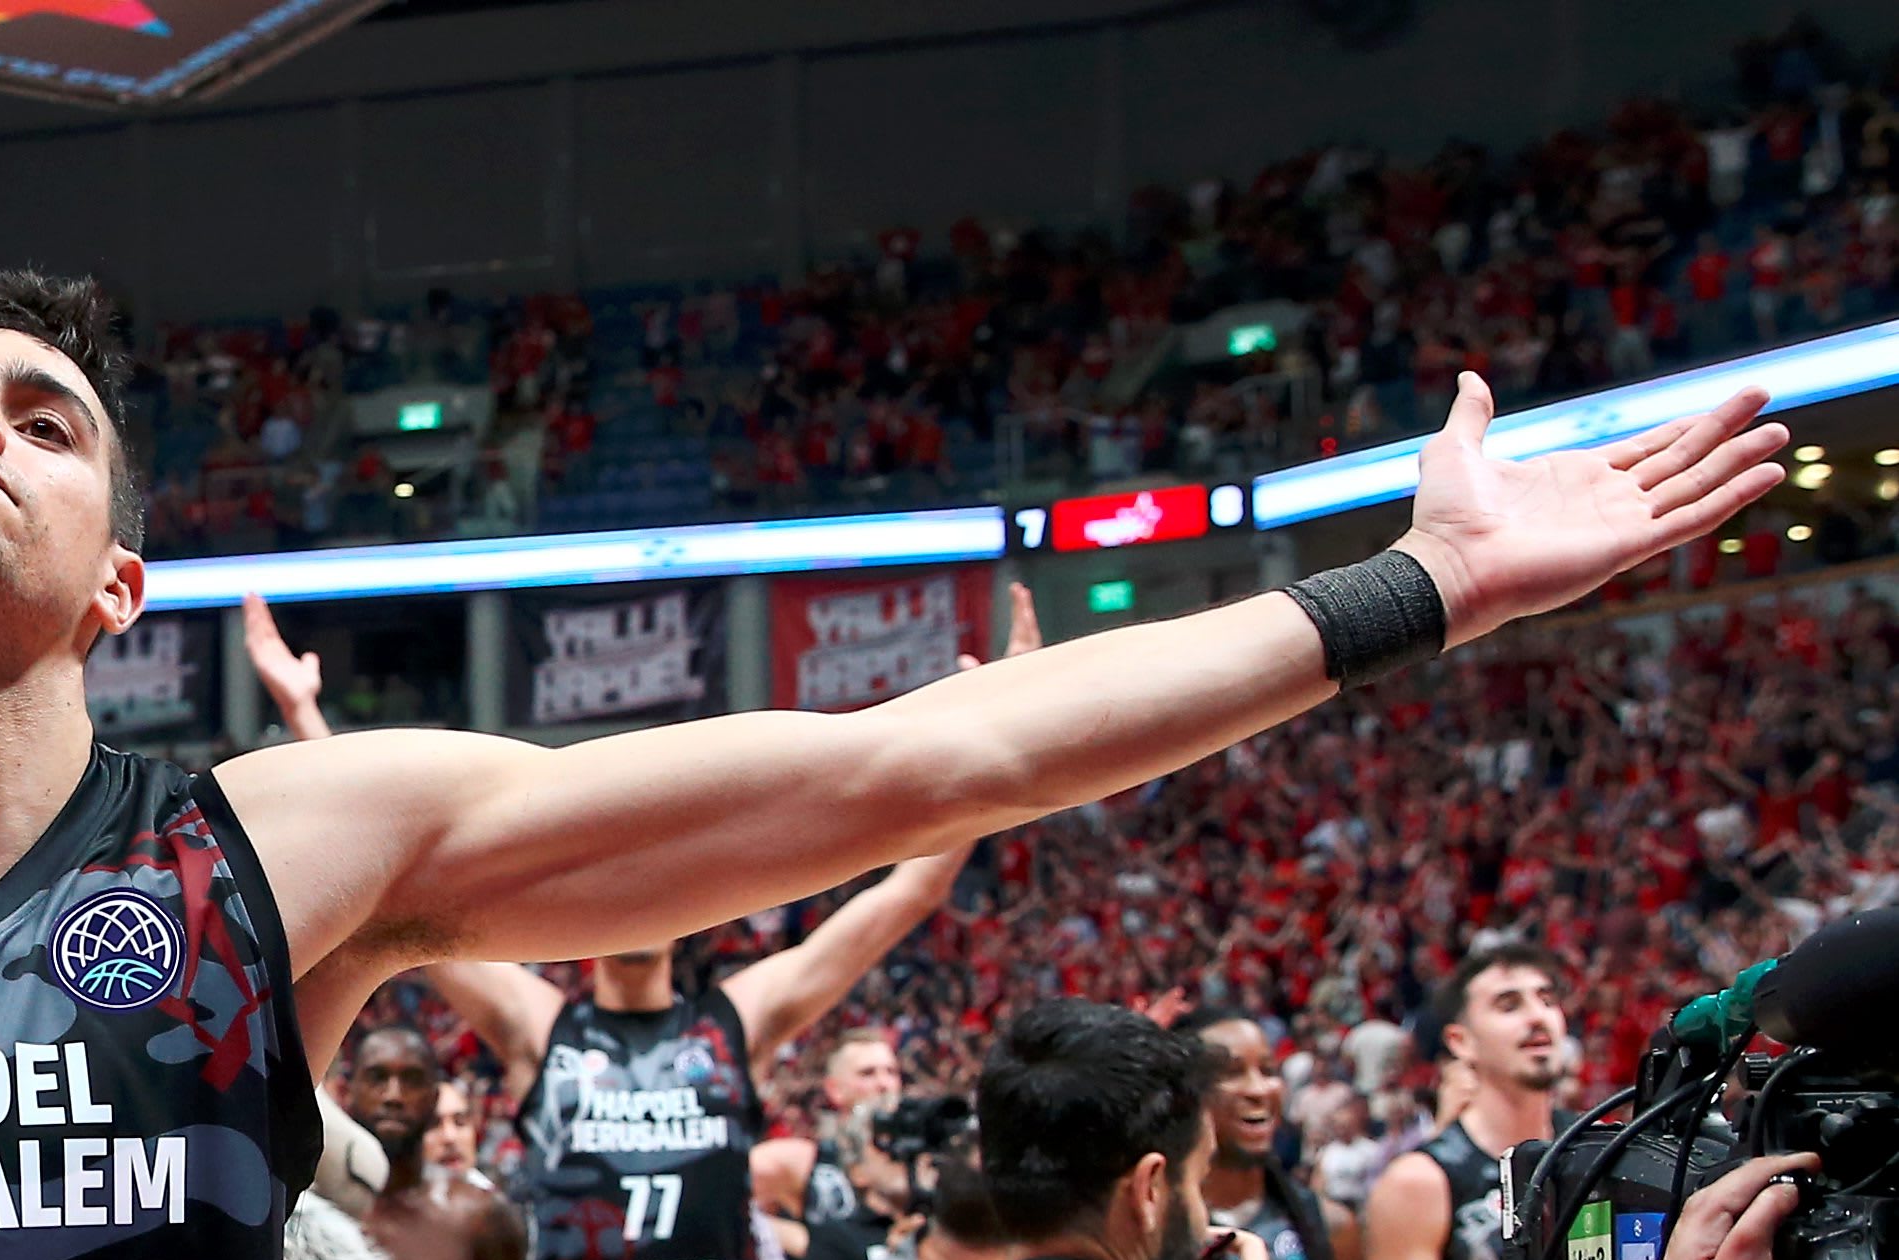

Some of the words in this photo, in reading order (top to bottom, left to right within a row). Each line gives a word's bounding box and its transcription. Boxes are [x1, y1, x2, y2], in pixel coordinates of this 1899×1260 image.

[1015, 507, 1046, 548] 7
[545, 593, 686, 660] YALLA
[806, 575, 954, 647] YALLA
[589, 1086, 706, 1121] HAPOEL
[571, 1115, 728, 1152] JERUSALEM
[620, 1174, 683, 1241] 77
